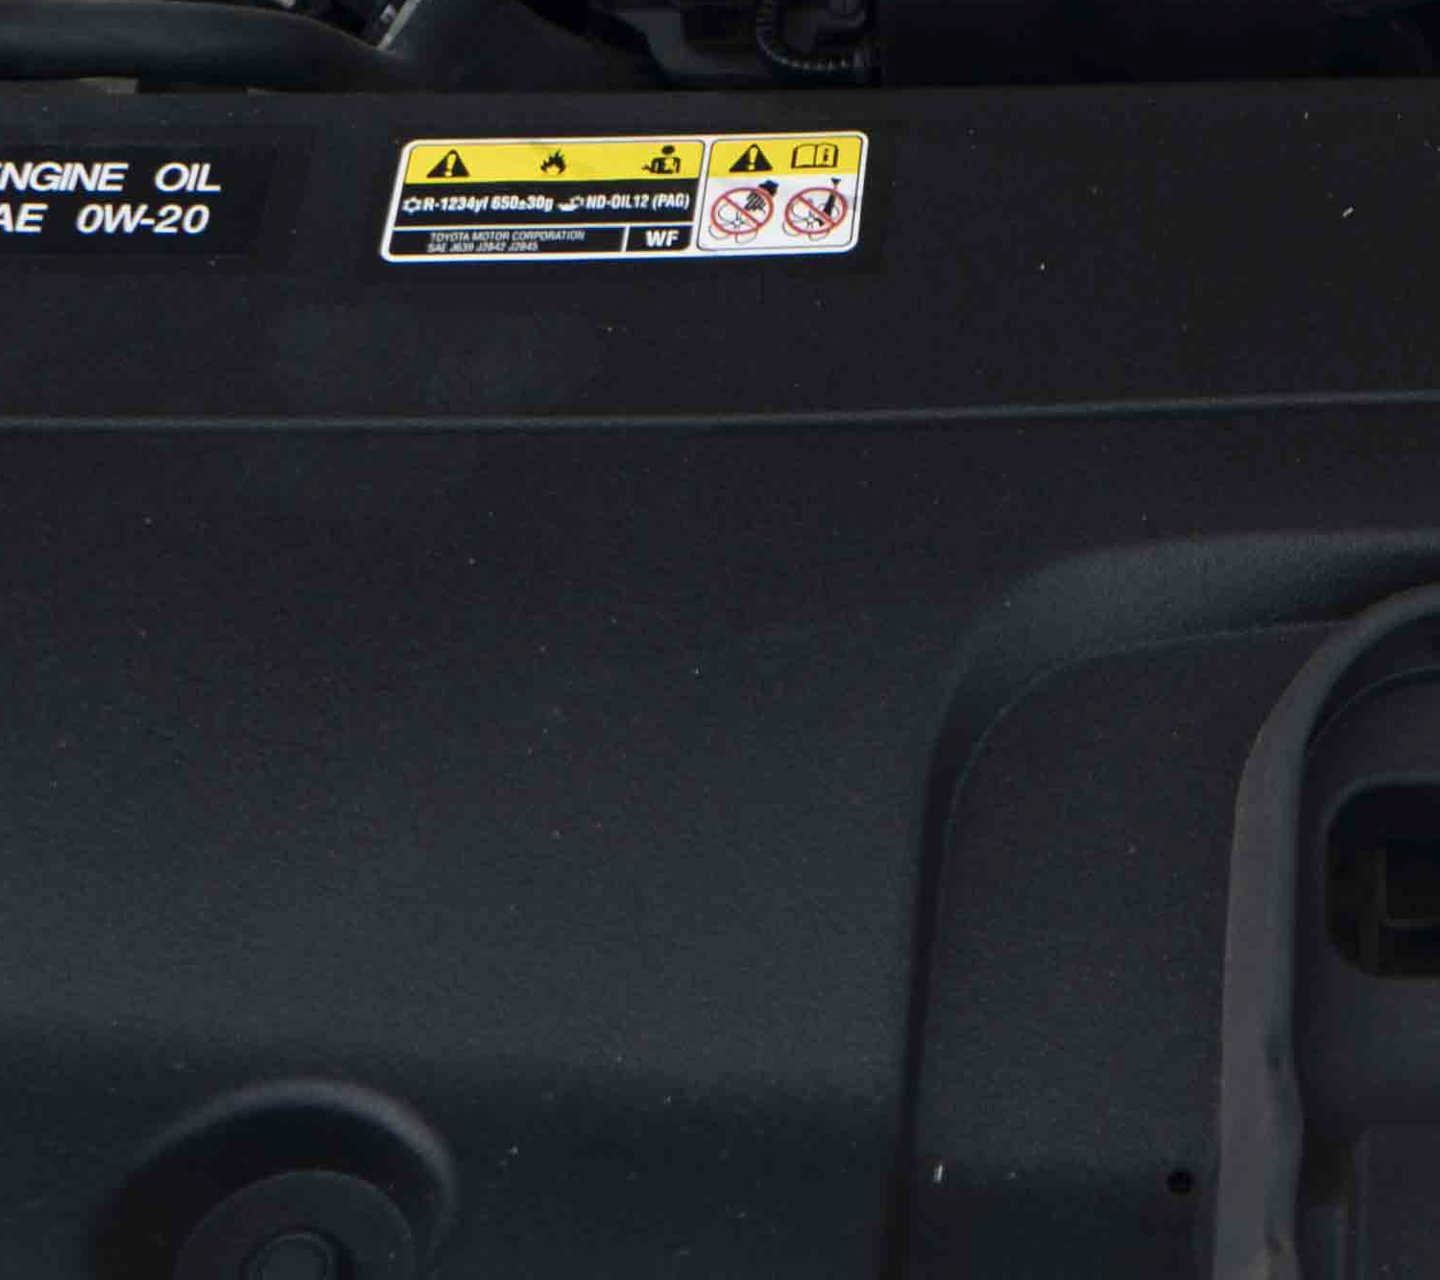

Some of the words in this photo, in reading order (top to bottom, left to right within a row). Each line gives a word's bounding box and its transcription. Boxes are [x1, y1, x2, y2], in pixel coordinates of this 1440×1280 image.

[153, 161, 222, 193] OIL
[491, 194, 554, 213] 650±30g
[586, 193, 649, 210] ND-OIL12
[652, 192, 690, 211] (PAG)
[75, 202, 211, 234] 0W-20
[430, 231, 470, 243] TOYOTA
[472, 230, 510, 242] MOTOR
[512, 229, 585, 242] CORPORATION
[645, 229, 680, 247] WF
